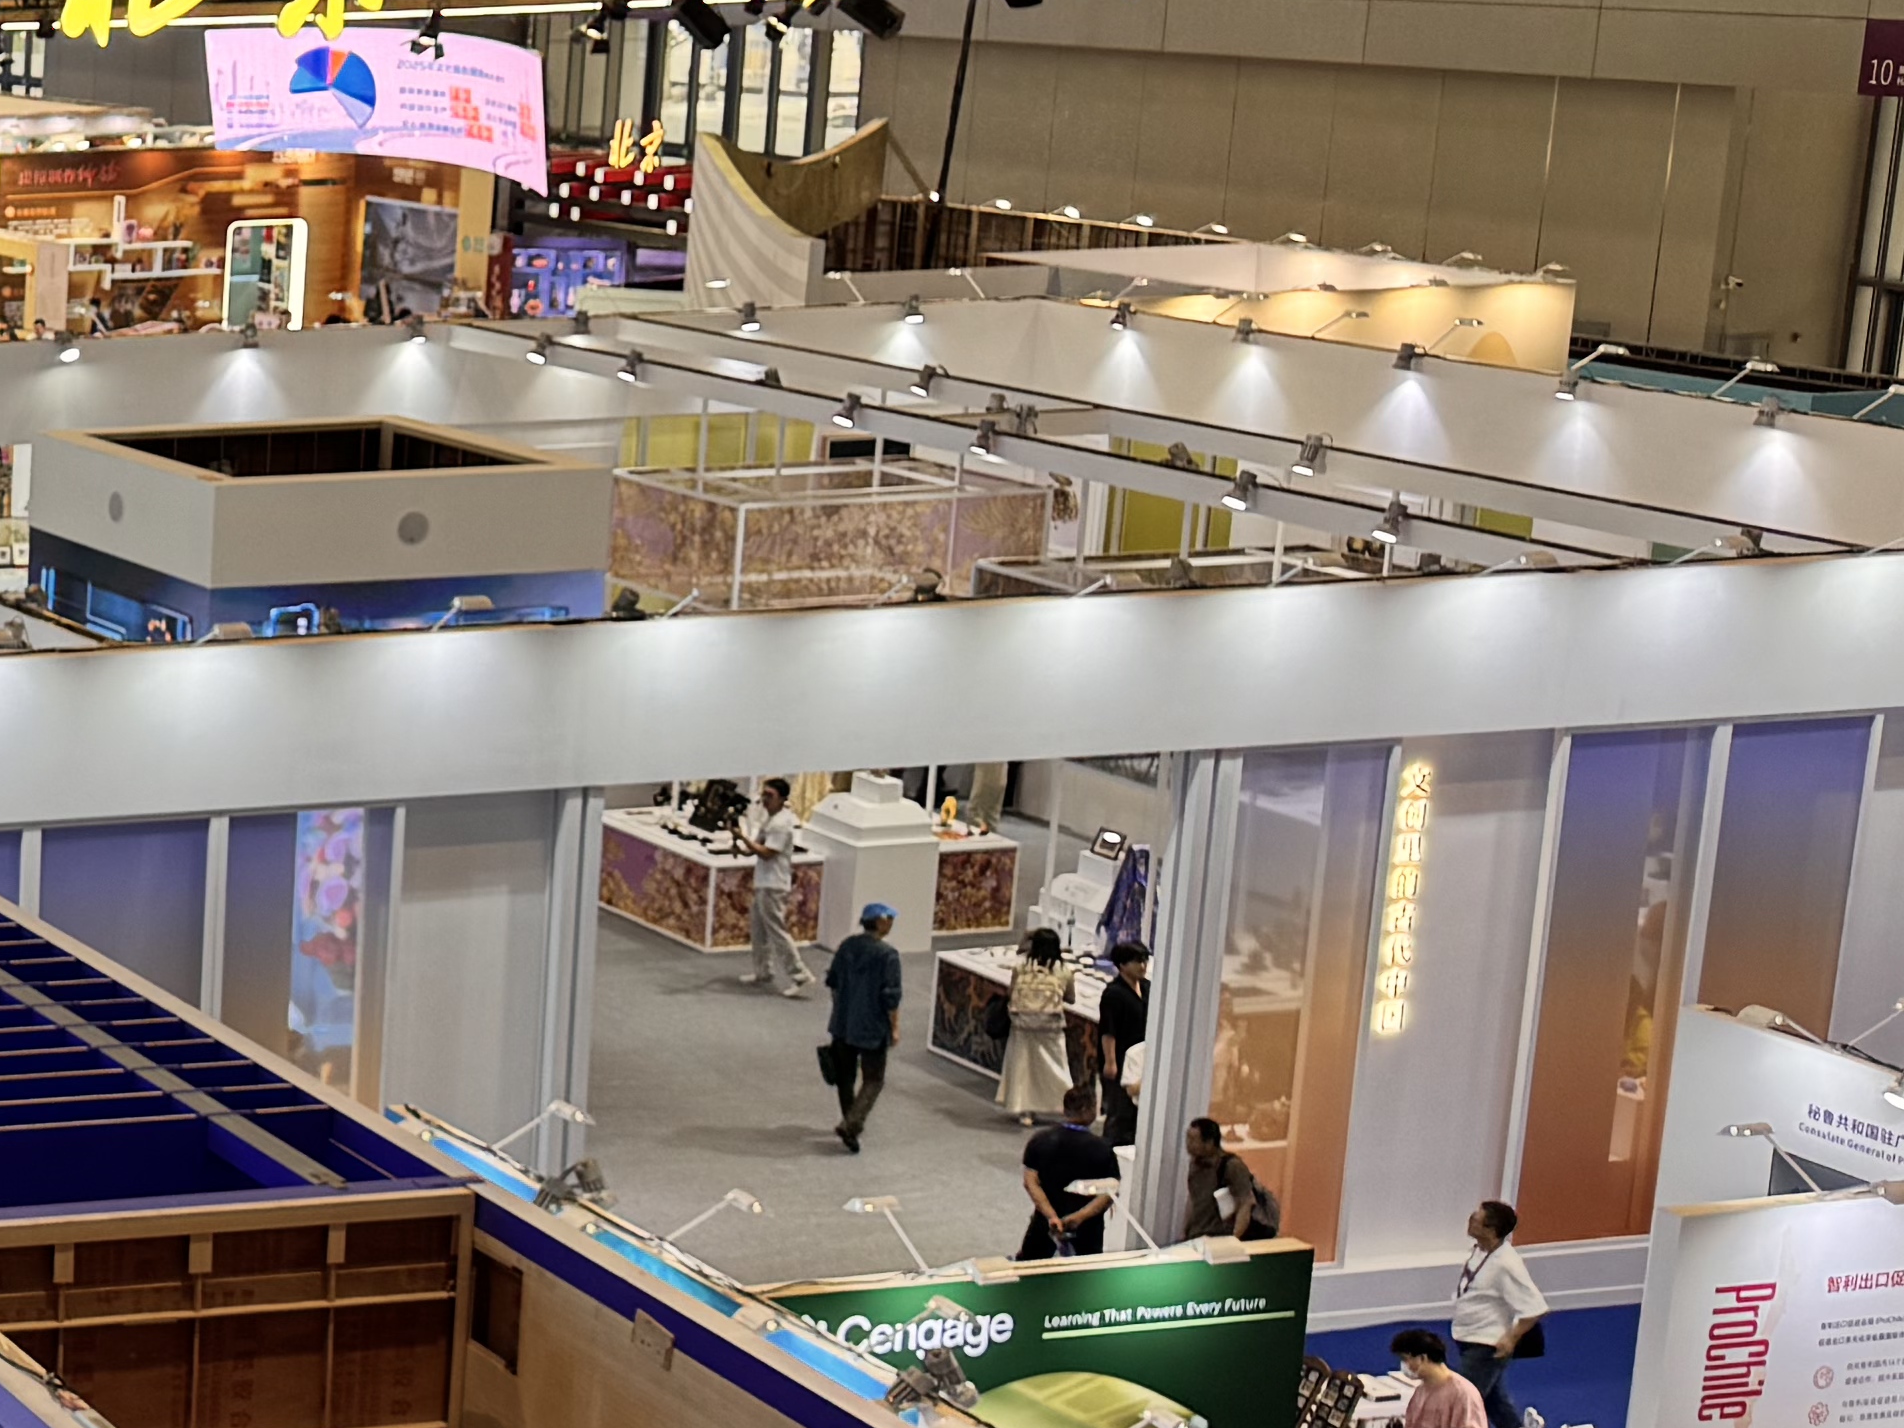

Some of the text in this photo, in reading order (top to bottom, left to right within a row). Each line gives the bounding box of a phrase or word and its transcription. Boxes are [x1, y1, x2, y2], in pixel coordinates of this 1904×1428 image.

[1868, 59, 1894, 85] 10
[608, 118, 664, 173] 北京
[1847, 1138, 1885, 1160] General
[1886, 1153, 1896, 1163] of
[1043, 1310, 1101, 1329] Learning
[1103, 1307, 1133, 1324] That
[1186, 1300, 1222, 1319] Every
[1224, 1296, 1267, 1314] Future
[836, 1311, 1015, 1358] Cengage
[1698, 1280, 1778, 1422] ProChile
